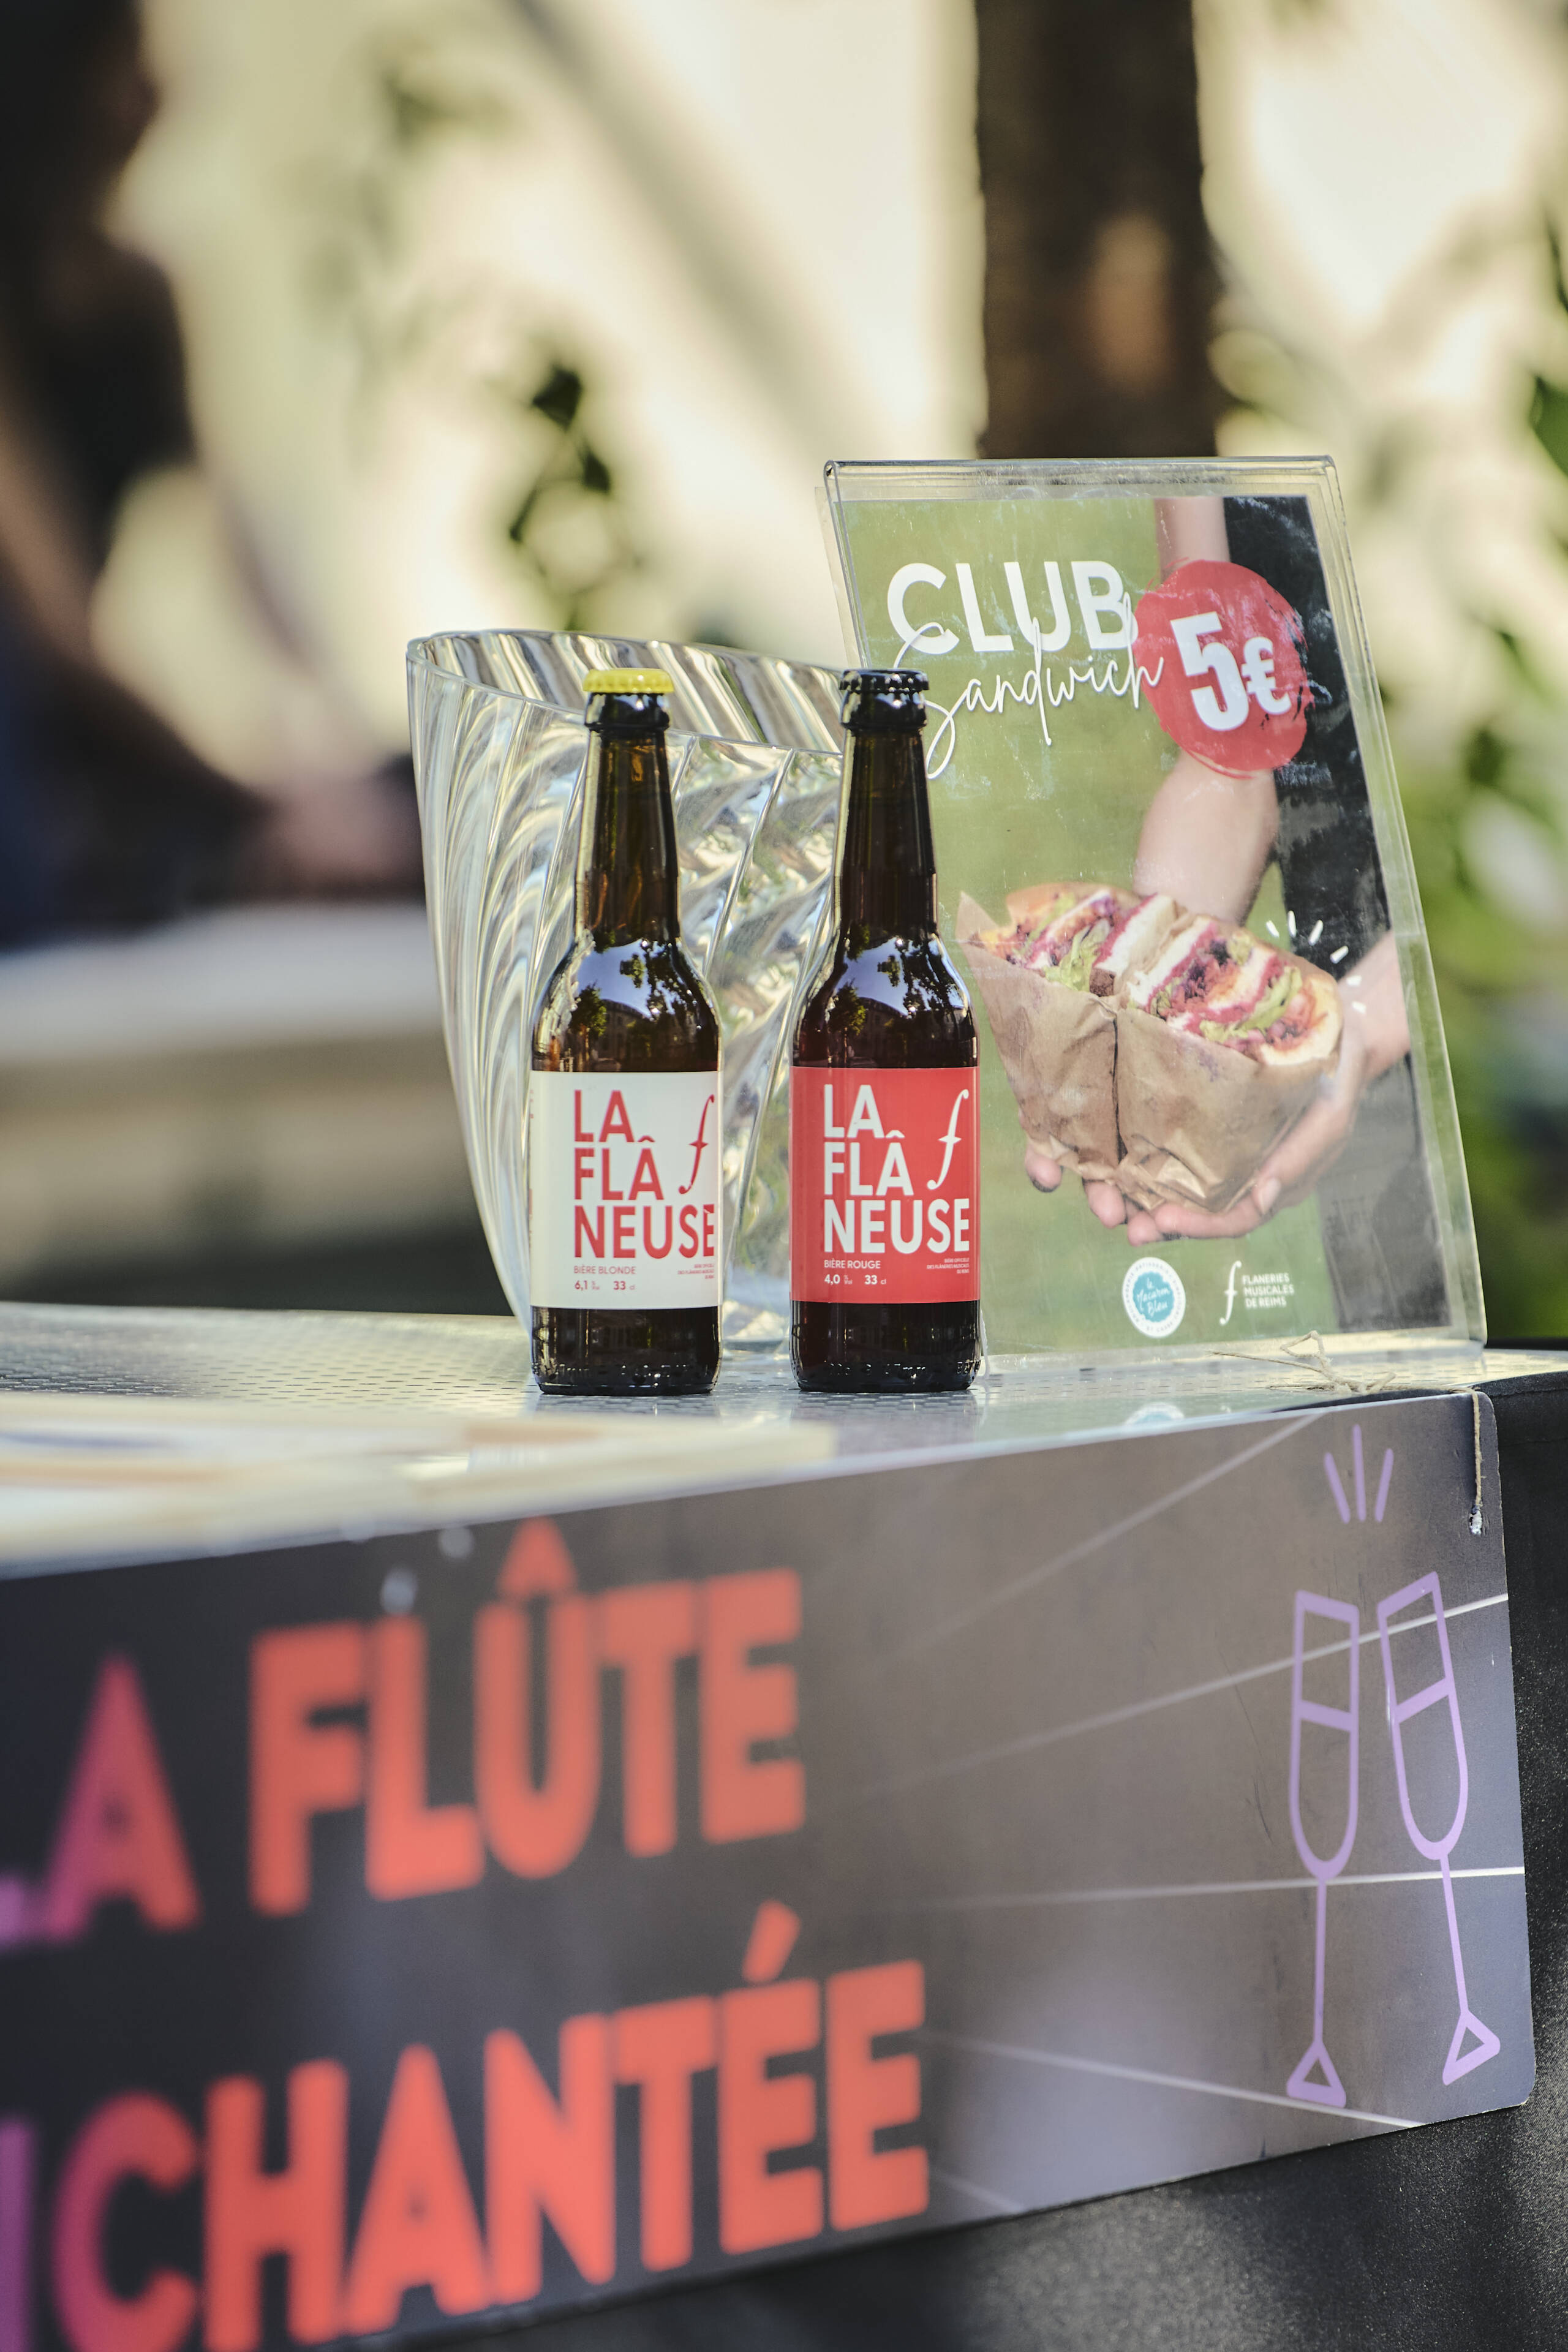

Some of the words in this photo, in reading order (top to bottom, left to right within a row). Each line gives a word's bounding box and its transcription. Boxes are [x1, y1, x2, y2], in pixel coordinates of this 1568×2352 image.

[887, 560, 1138, 655] CLUB
[1169, 611, 1292, 731] 5€
[574, 1090, 634, 1142] LA
[824, 1085, 884, 1139] LA
[574, 1135, 665, 1200] FLÂ
[824, 1129, 914, 1196] FLÂ
[574, 1204, 715, 1259] NEUSE
[824, 1198, 970, 1254] NEUSE
[574, 1280, 589, 1291] 6,1
[598, 1265, 636, 1275] BLONDE
[612, 1280, 627, 1291] 33
[824, 1257, 845, 1268] BIÈRE
[847, 1260, 881, 1269] ROUGE
[824, 1274, 841, 1285] 4,0
[864, 1274, 878, 1285] 33
[1243, 1283, 1295, 1297] MUSICALES
[1245, 1297, 1258, 1308] DE
[1259, 1296, 1287, 1308] REIMS
[0, 1648, 202, 1947] A
[249, 1514, 809, 1922] FLÛTE
